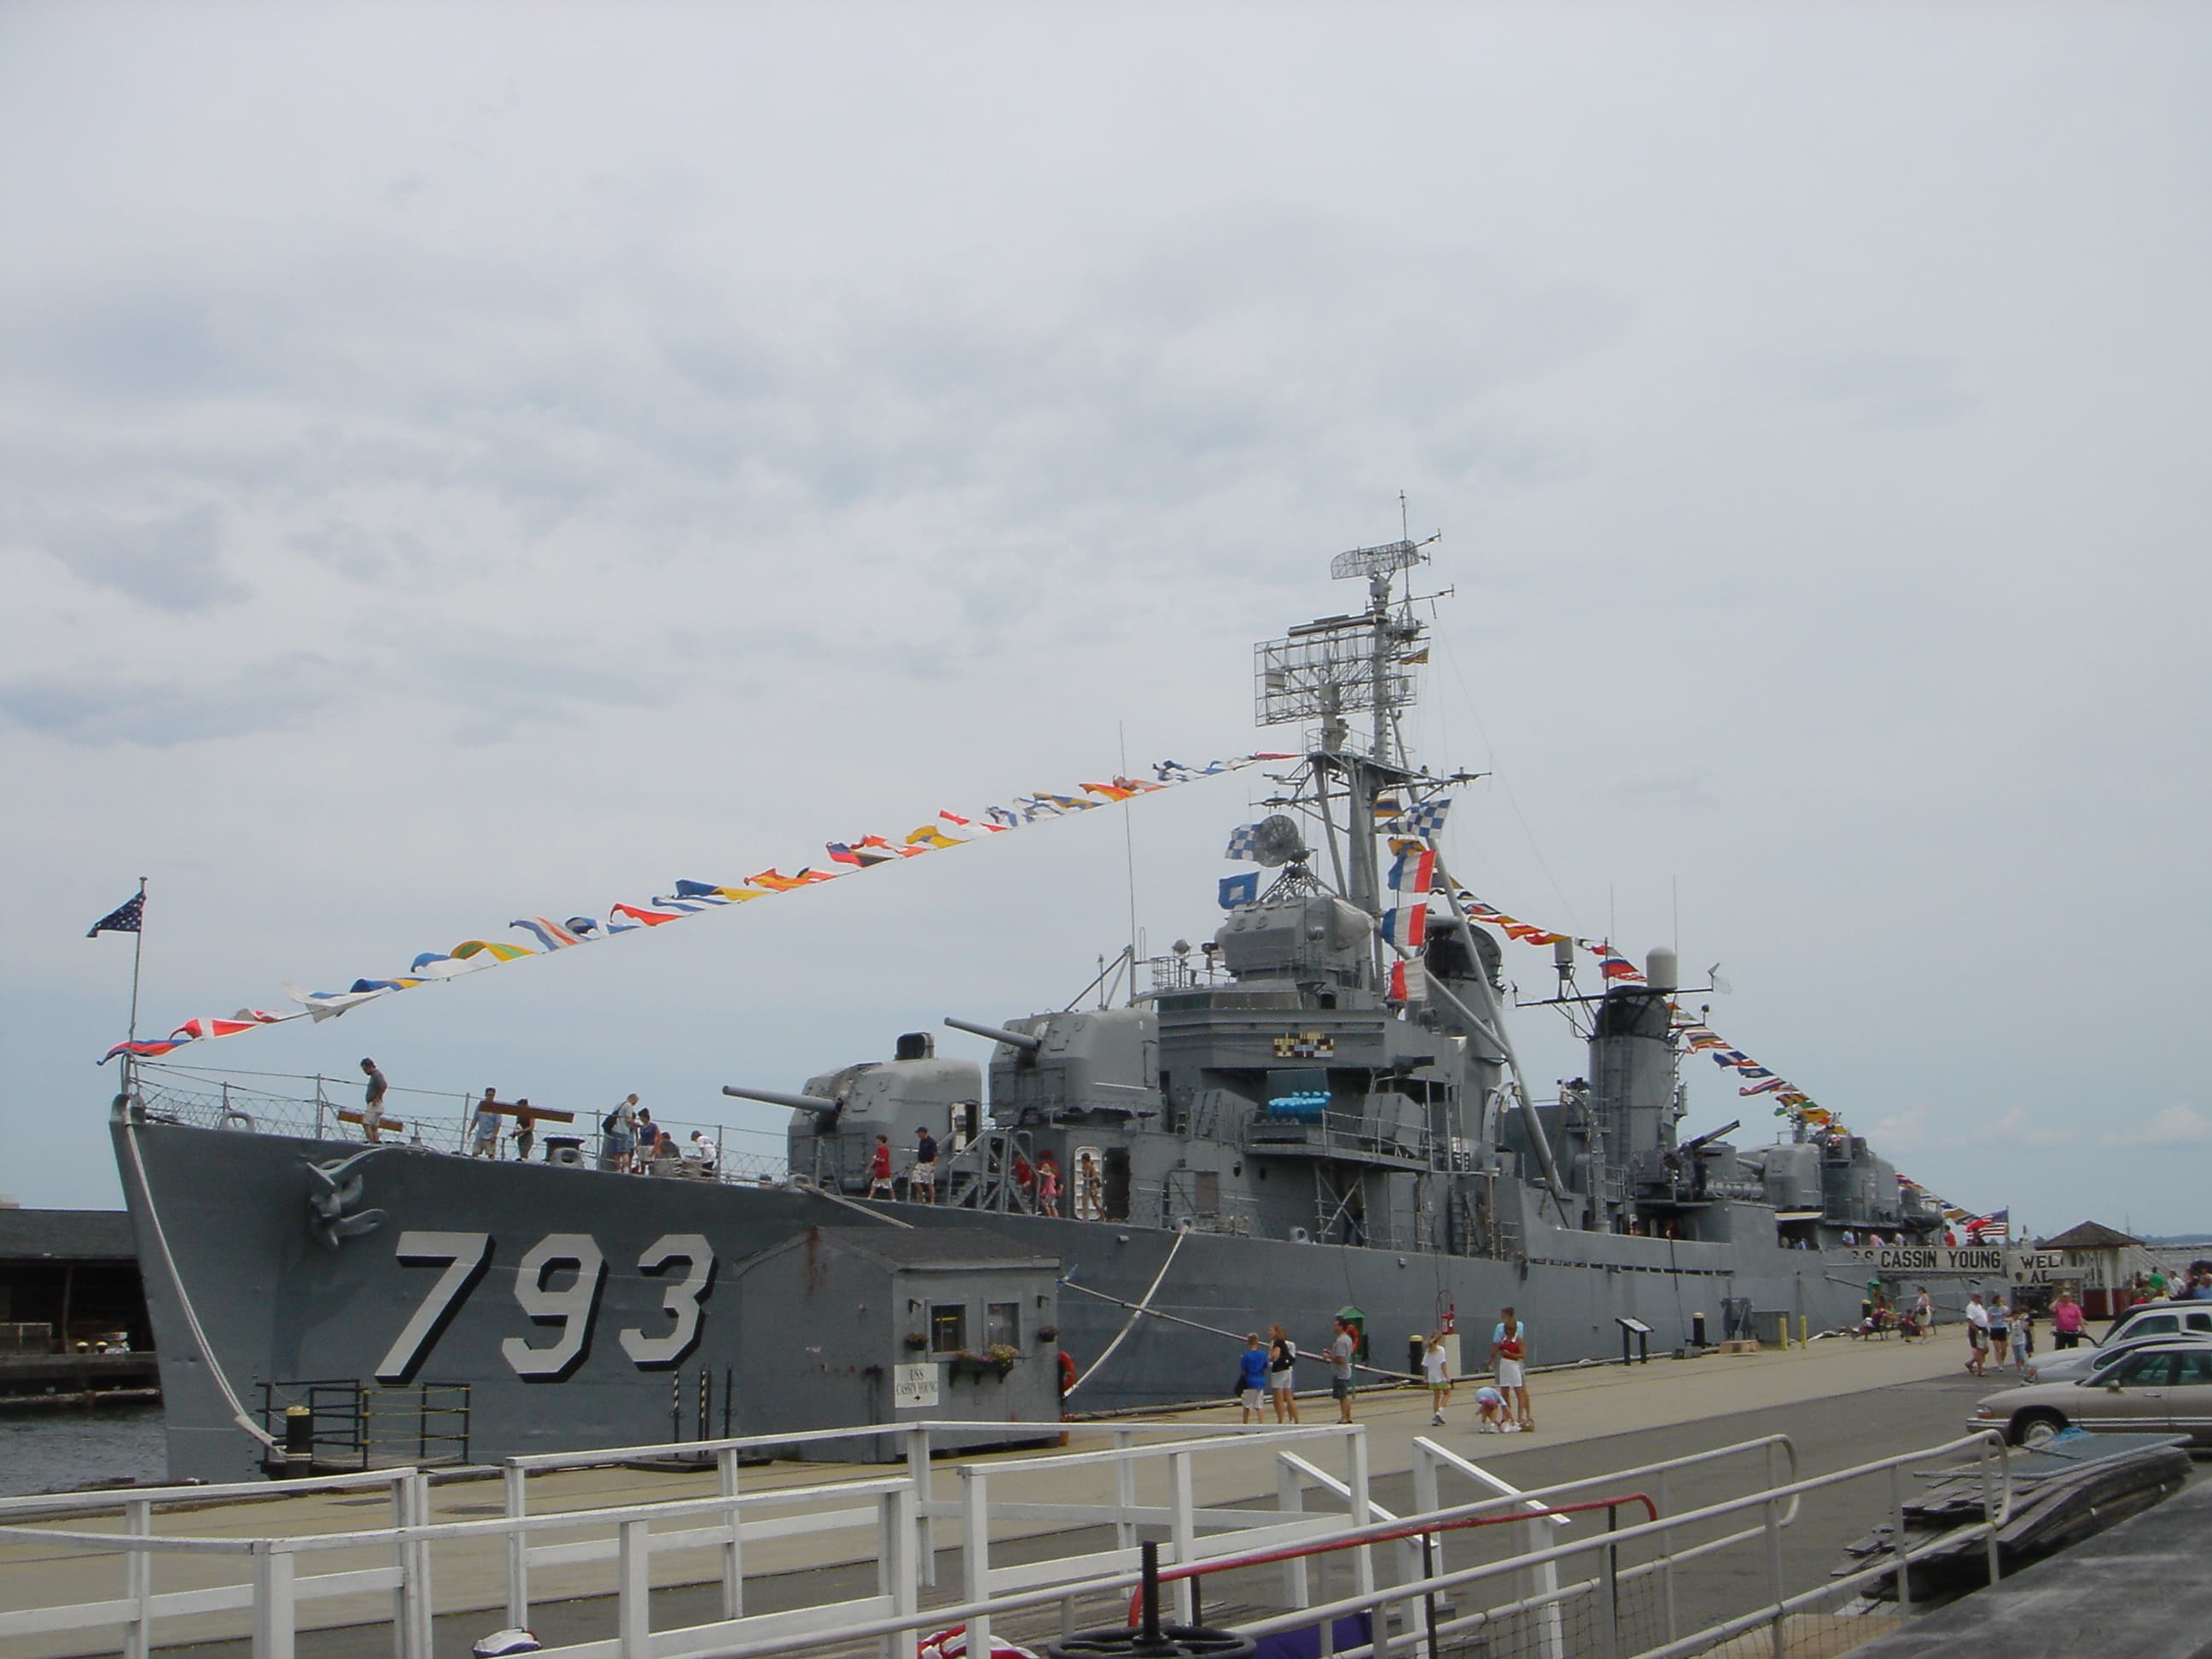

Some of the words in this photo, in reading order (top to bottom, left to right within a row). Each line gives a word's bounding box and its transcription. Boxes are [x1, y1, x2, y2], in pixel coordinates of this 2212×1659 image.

[1880, 1250, 1936, 1268] CASSIN
[1947, 1250, 2001, 1269] YOUNG
[375, 1231, 718, 1384] 793
